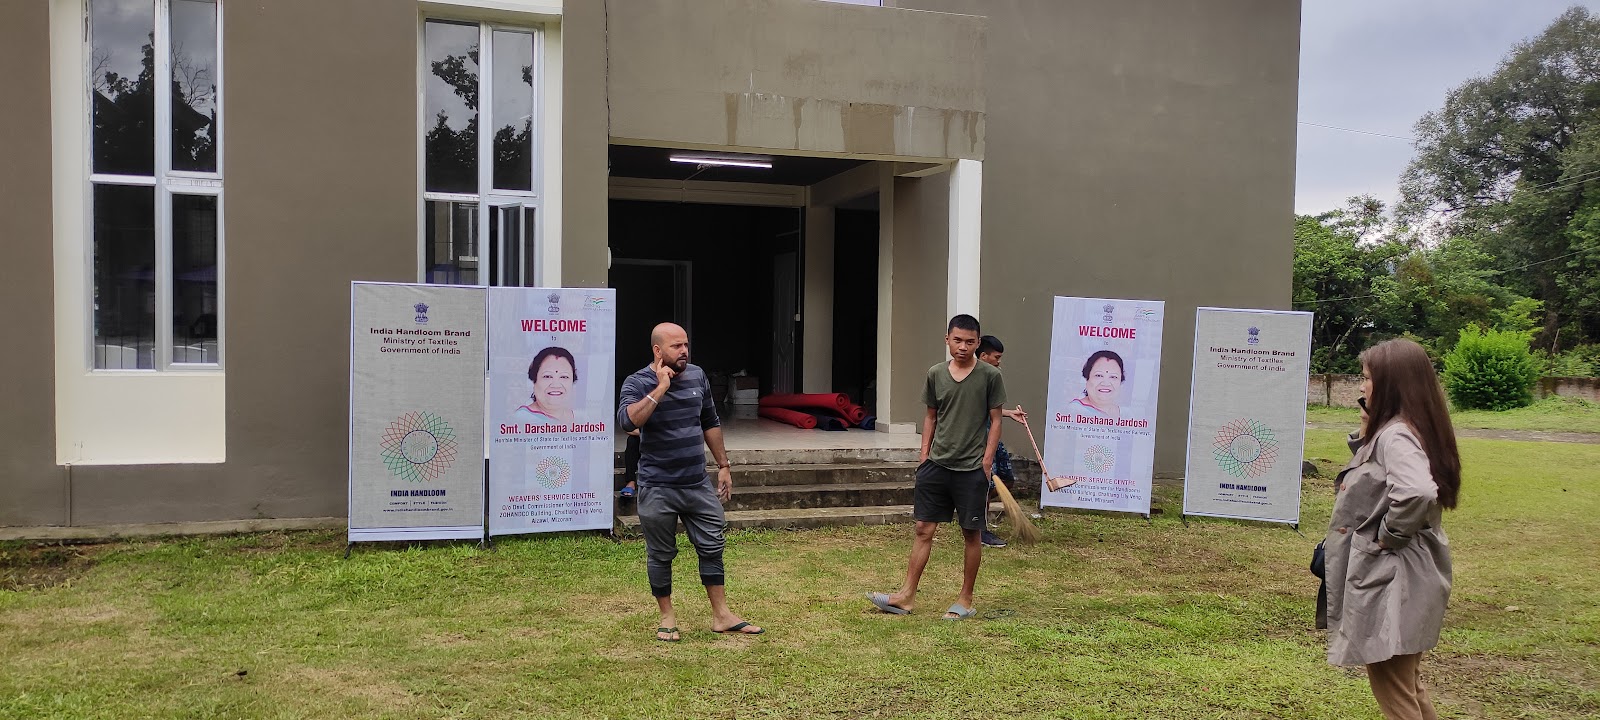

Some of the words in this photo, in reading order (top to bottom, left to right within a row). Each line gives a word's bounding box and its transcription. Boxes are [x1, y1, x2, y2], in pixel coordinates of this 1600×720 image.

[397, 328, 441, 336] Handloom
[521, 320, 586, 332] WELCOME
[1079, 325, 1136, 339] WELCOME
[381, 346, 429, 354] Government
[1056, 413, 1074, 423] Smt.
[1076, 415, 1114, 426] Darshana
[1116, 417, 1148, 428] Jardosh
[500, 424, 521, 434] Smt.
[525, 423, 567, 434] Darshana
[570, 422, 605, 433] Jardosh
[509, 494, 541, 502] WEAVERS'
